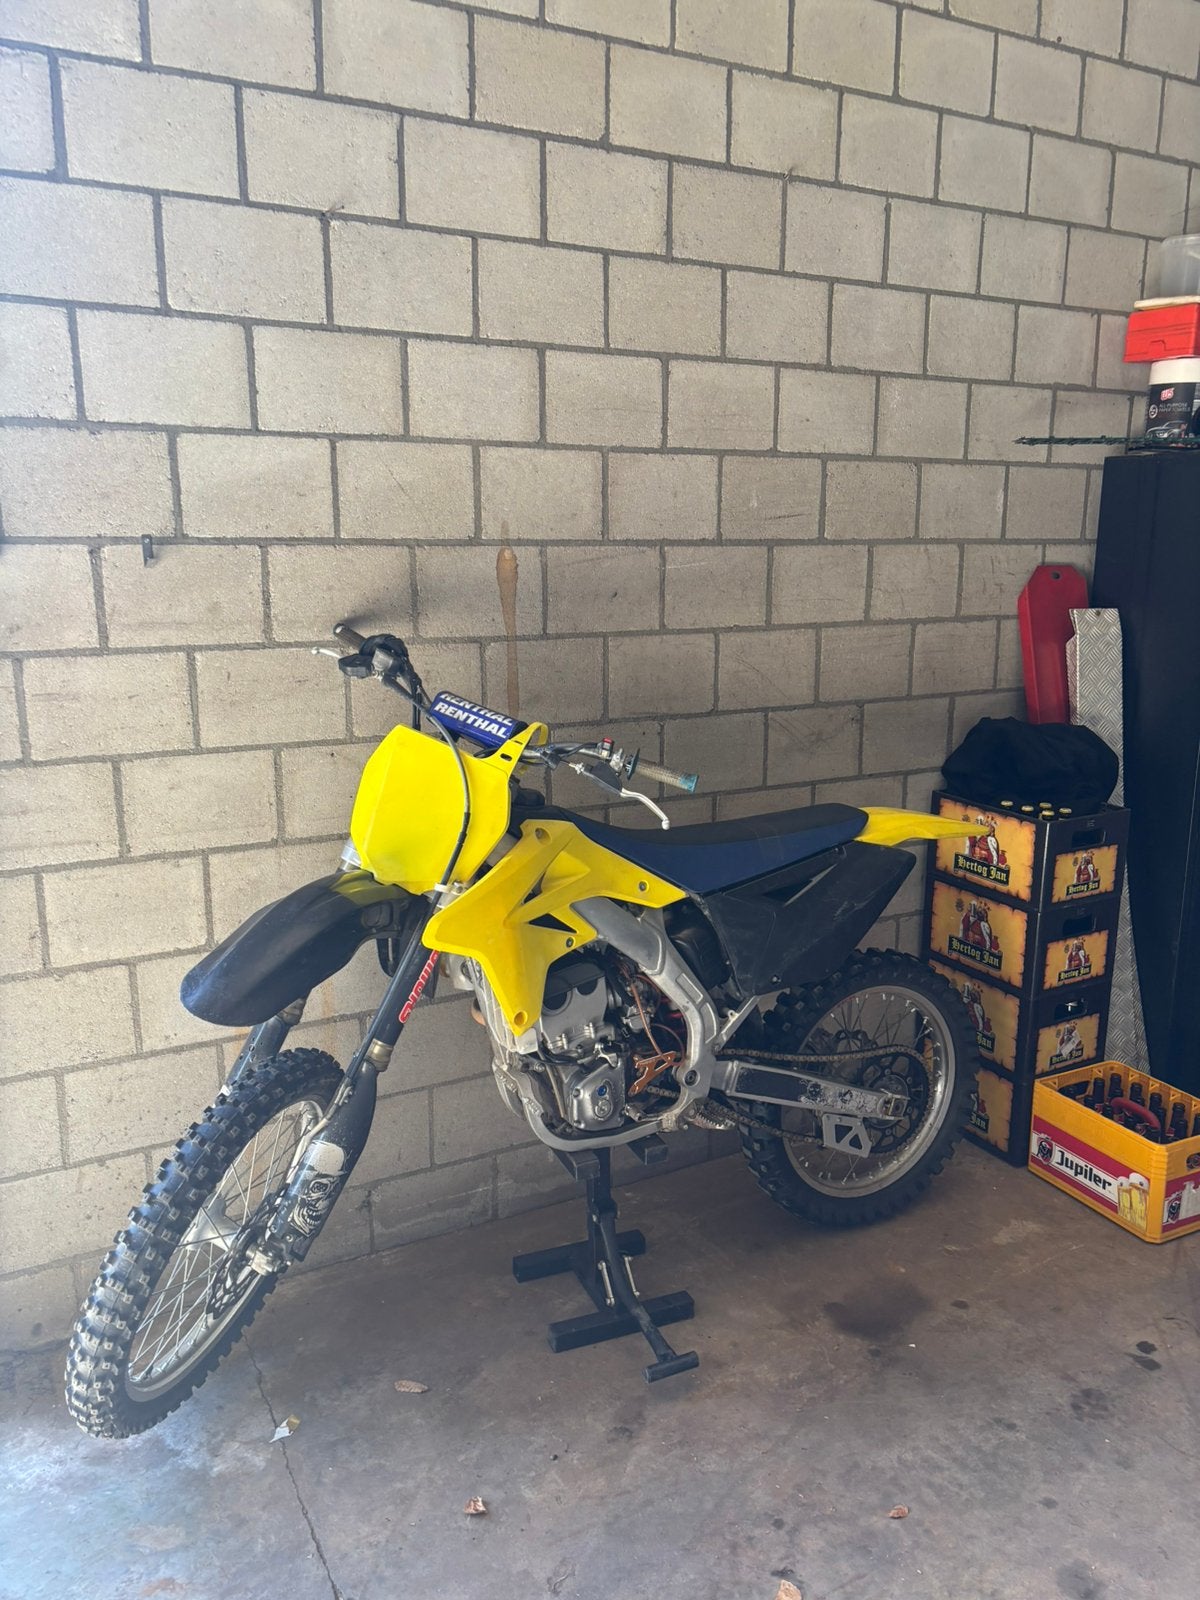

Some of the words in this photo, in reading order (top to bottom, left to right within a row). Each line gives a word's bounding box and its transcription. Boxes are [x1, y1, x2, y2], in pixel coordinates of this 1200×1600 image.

[434, 701, 507, 739] RENTHAL
[958, 855, 988, 877] Hertog
[989, 866, 1007, 882] Jan
[951, 938, 981, 961] Hertog
[982, 951, 999, 967] Jan
[1055, 1150, 1112, 1190] Jupiler
